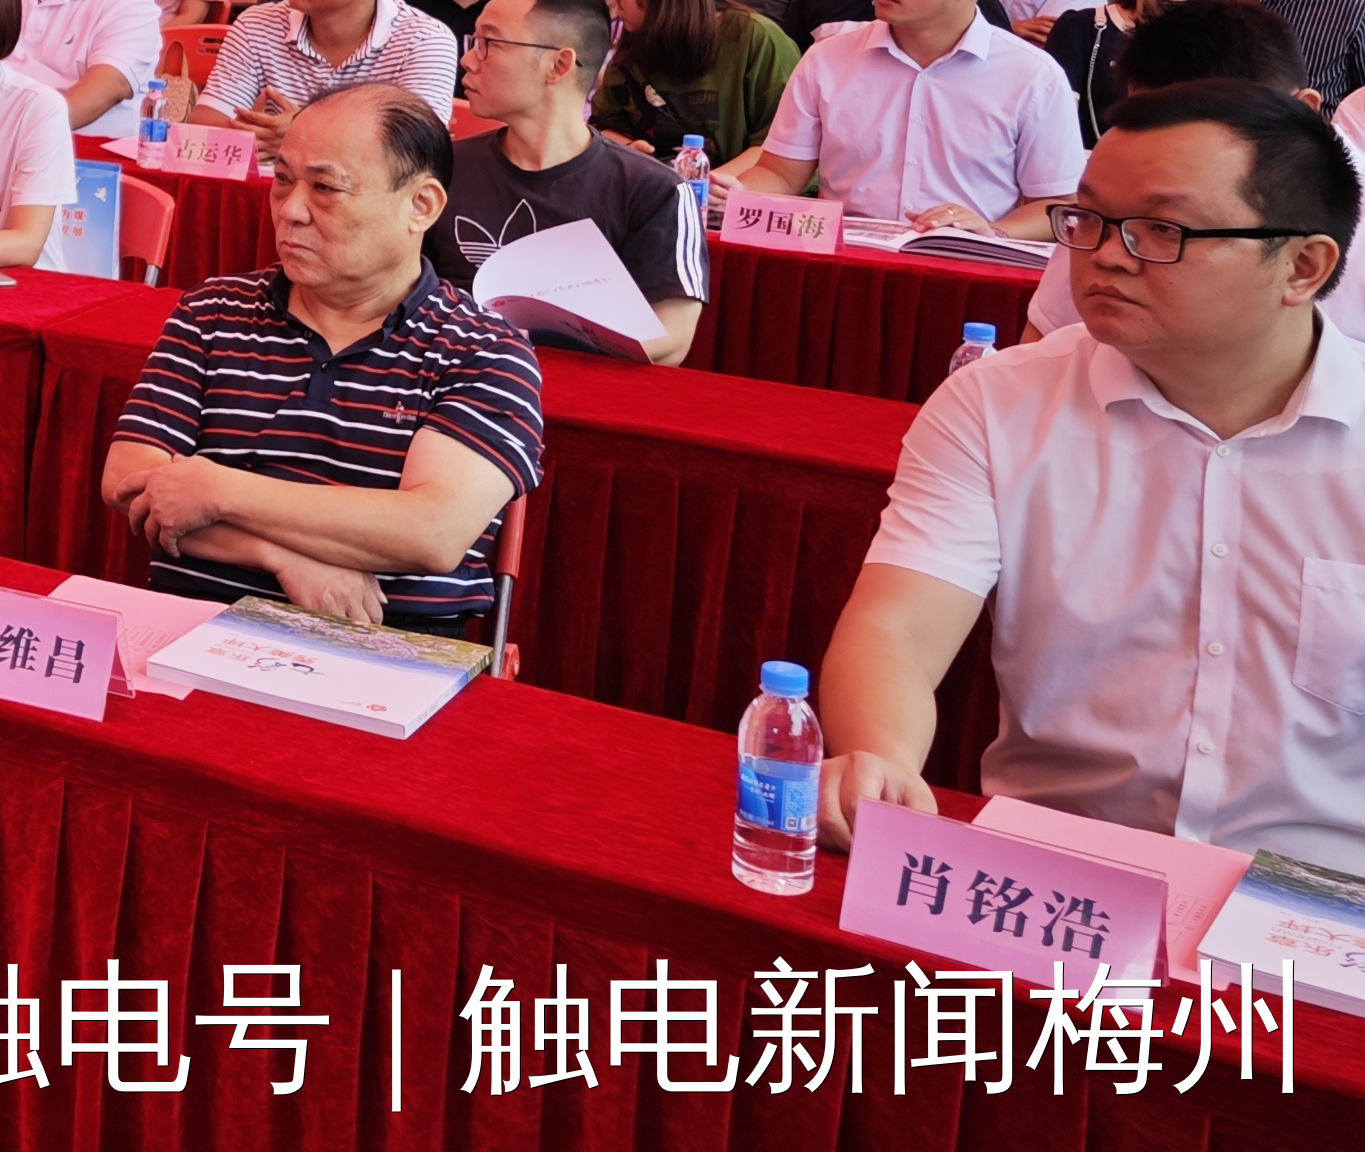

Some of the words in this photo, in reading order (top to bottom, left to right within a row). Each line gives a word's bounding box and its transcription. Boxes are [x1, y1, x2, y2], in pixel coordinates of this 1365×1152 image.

[175, 138, 243, 166] 古运华
[737, 202, 827, 241] 罗国海
[896, 851, 1112, 961] 肖铭浩
